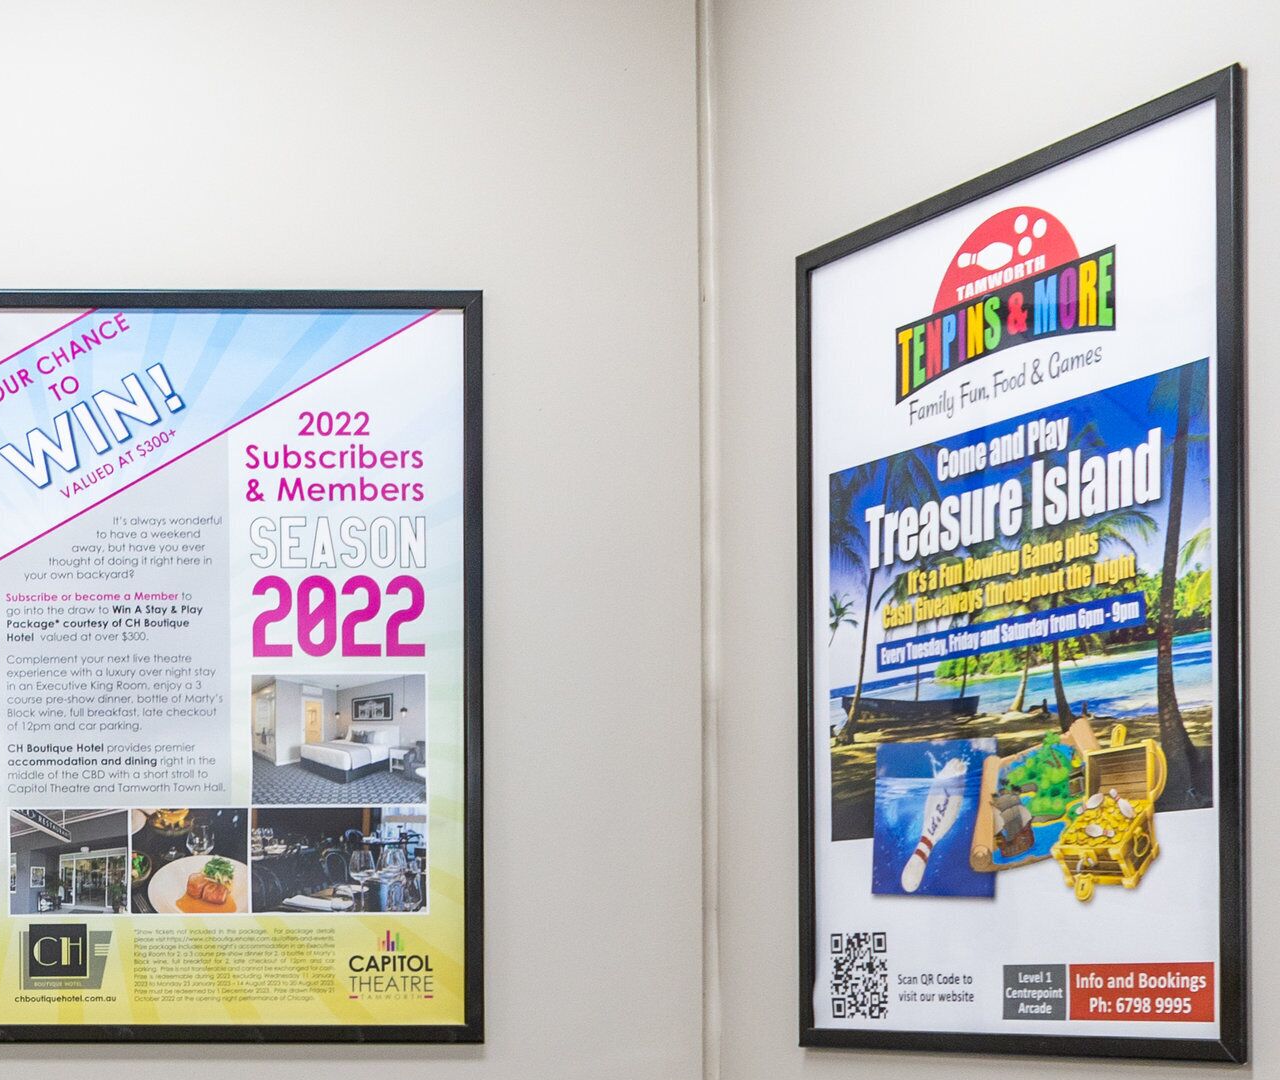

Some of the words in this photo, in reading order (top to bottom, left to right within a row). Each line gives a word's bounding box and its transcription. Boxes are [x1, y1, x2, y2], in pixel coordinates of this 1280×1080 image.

[36, 312, 130, 375] CHANCE
[48, 376, 79, 401] TO
[297, 410, 370, 436] 2022
[245, 443, 423, 469] Subscribers
[937, 440, 987, 481] Come
[989, 424, 1025, 465] and
[1027, 416, 1070, 456] Play
[60, 463, 114, 498] VALUED
[118, 451, 135, 469] AT
[136, 429, 176, 458] $300+
[245, 478, 265, 502] &
[277, 476, 424, 501] Members
[865, 477, 1023, 570] Treasure
[1032, 427, 1162, 530] Island
[249, 515, 427, 569] SEASON
[251, 574, 425, 657] 2022
[7, 743, 23, 753] CH
[26, 743, 73, 754] Boutique
[76, 742, 104, 752] Hotel
[106, 743, 151, 754] provides
[154, 744, 194, 753] premier
[348, 954, 433, 972] CAPITOL
[348, 975, 434, 992] THEATRE
[897, 973, 918, 985] Scan
[920, 973, 934, 986] QR
[936, 972, 960, 985] Code
[962, 974, 973, 985] to
[14, 994, 116, 1004] chboutiquehotel.com.au
[898, 990, 917, 1002] visit
[919, 993, 935, 1002] our
[937, 990, 974, 1002] website
